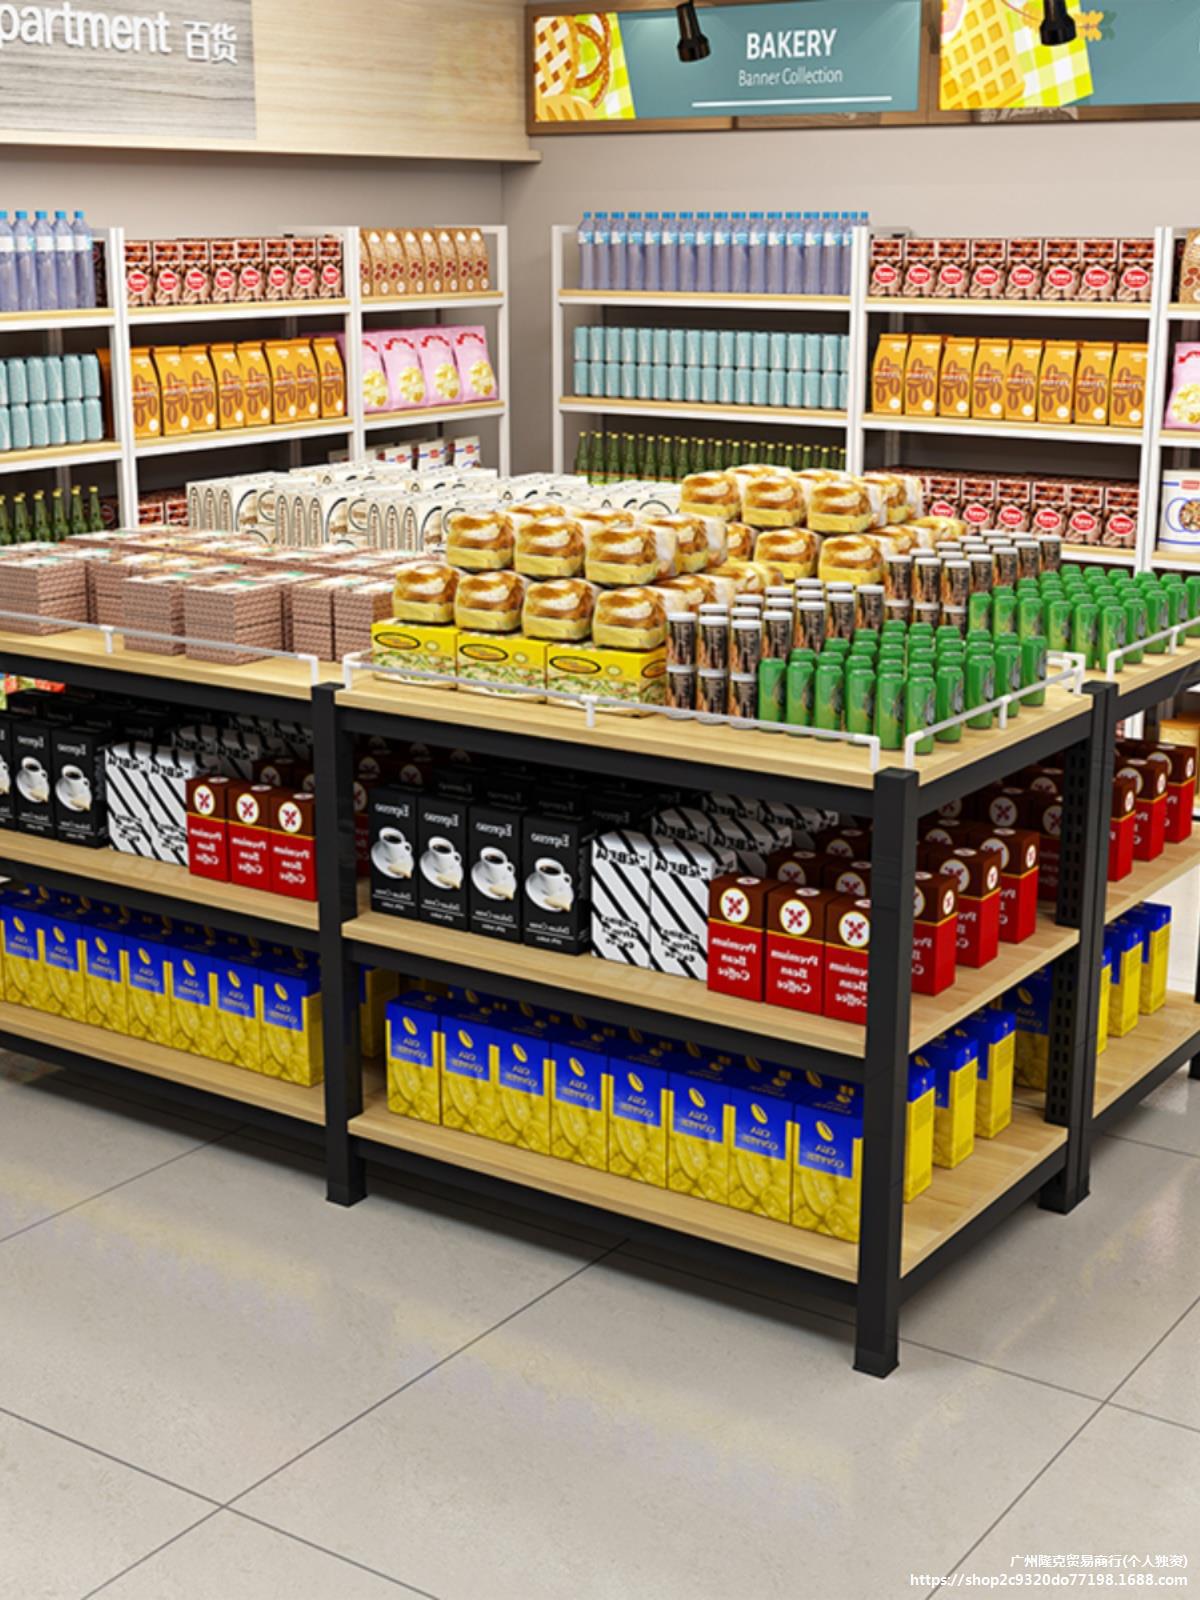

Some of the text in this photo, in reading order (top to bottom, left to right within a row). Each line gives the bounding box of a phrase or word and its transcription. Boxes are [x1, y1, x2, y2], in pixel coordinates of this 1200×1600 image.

[185, 21, 238, 64] 百货
[746, 29, 836, 60] BAKERY
[738, 66, 843, 87] Banner Collection
